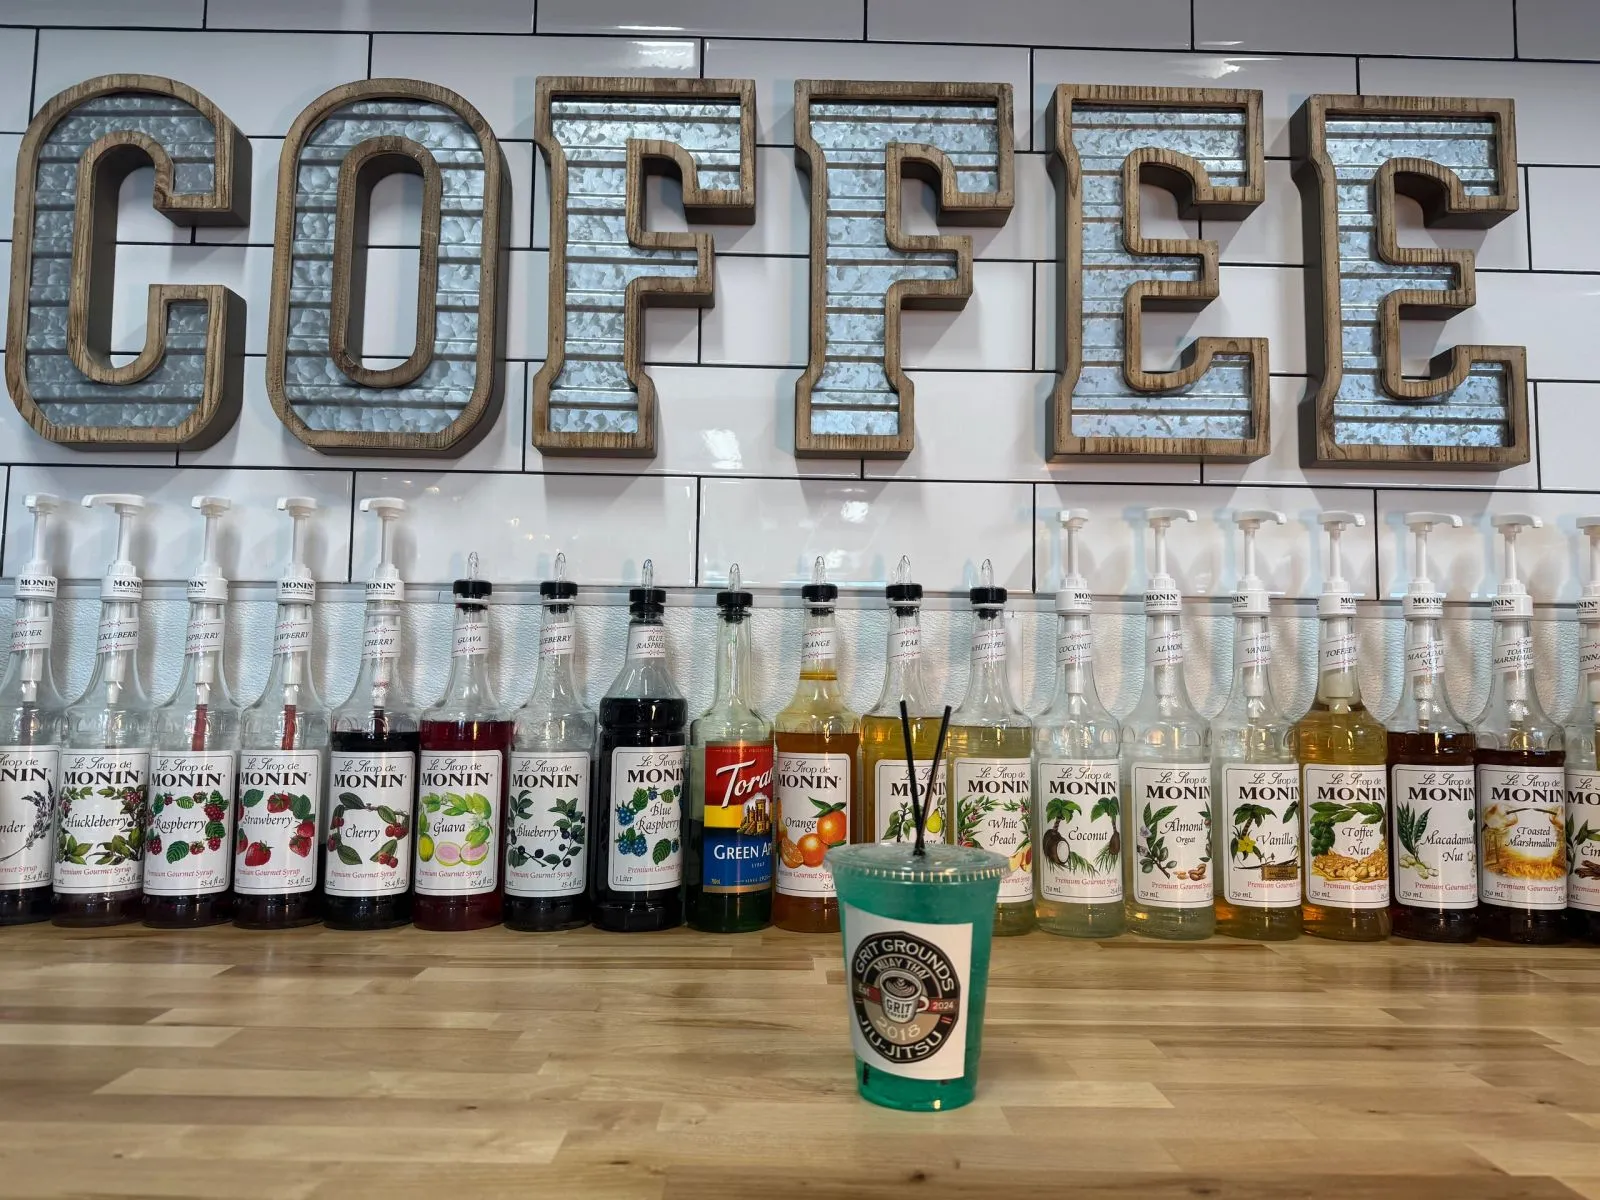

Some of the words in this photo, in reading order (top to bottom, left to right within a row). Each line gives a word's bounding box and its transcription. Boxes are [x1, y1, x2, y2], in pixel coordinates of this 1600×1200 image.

[5, 73, 1530, 471] COFFEE
[20, 578, 56, 587] MONIN
[281, 581, 313, 590] MONIN
[1145, 593, 1177, 602] MONIN
[364, 637, 394, 648] CHERRY
[457, 635, 482, 645] GUAVA
[802, 638, 831, 650] RANGE
[25, 758, 39, 766] de
[86, 757, 117, 771] Sirop
[119, 760, 132, 769] de
[170, 758, 198, 773] Sirop
[201, 763, 213, 771] de
[258, 757, 284, 773] Sirop
[287, 762, 300, 770] de
[354, 759, 383, 775] Sirop
[384, 764, 397, 772] de
[440, 758, 468, 773] Sirop
[470, 762, 482, 770] de
[532, 759, 558, 775] Sirop
[560, 764, 572, 772] de
[636, 755, 652, 767] Le
[653, 753, 677, 769] Sirop
[792, 760, 818, 775] Sirop
[819, 765, 831, 774] de
[0, 768, 48, 782] NIN
[64, 771, 140, 785] MONIN
[151, 772, 223, 787] MONIN
[240, 771, 309, 786] MONIN
[333, 774, 405, 788] MONIN
[421, 772, 490, 787] MONIN
[512, 773, 579, 788] MONIN
[992, 766, 1017, 781] Sirop
[1018, 770, 1026, 778] de
[1075, 766, 1100, 781] Sirop
[1101, 771, 1112, 779] de
[1174, 771, 1200, 787] Sirop
[1200, 776, 1208, 784] de
[1248, 773, 1266, 785] Le
[1268, 772, 1292, 788] Sirop
[1346, 772, 1372, 788] Sirop
[1373, 777, 1382, 785] de
[1437, 772, 1464, 789] Sirop
[716, 758, 774, 809] Tora
[778, 774, 839, 789] MONIN
[968, 780, 1029, 794] MONIN
[1049, 780, 1117, 796] MONIN
[1522, 774, 1550, 789] Sirop
[1576, 777, 1593, 789] Le
[1146, 784, 1211, 800] MONIN
[1318, 786, 1386, 801] MONIN
[1408, 786, 1475, 801] MONIN
[1491, 787, 1565, 803] MONIN
[650, 801, 673, 817] Blue
[65, 813, 129, 830] Huckleberry
[155, 814, 206, 834] Raspberry
[242, 810, 293, 829] Strawberry
[433, 817, 466, 837] Guava
[635, 816, 681, 835] Raspberry
[784, 817, 817, 833] Orange
[987, 816, 1018, 831] White
[1159, 817, 1204, 835] Almond
[344, 823, 381, 843] Cherry
[515, 822, 559, 842] Blueberry
[1068, 826, 1108, 842] Coconut
[1255, 831, 1294, 846] Vanilla
[1341, 826, 1374, 843] Toffee
[1516, 825, 1551, 837] Toasted
[989, 831, 1017, 847] Peach
[1175, 835, 1196, 846] Orgeat
[1504, 834, 1558, 849] Marshmallow
[713, 844, 757, 860] GREEN
[1347, 840, 1371, 857] Nut
[1442, 847, 1464, 862] Nut
[619, 875, 633, 883] Liter
[1151, 881, 1179, 890] Premium
[1323, 881, 1351, 890] Premium
[1415, 882, 1444, 891] Premium
[1496, 881, 1526, 891] Premium
[855, 940, 879, 974] GRIT
[881, 938, 955, 992] GROUNDS
[886, 997, 912, 1014] GRIT
[932, 1001, 954, 1010] 2024
[876, 1016, 921, 1041] 2018
